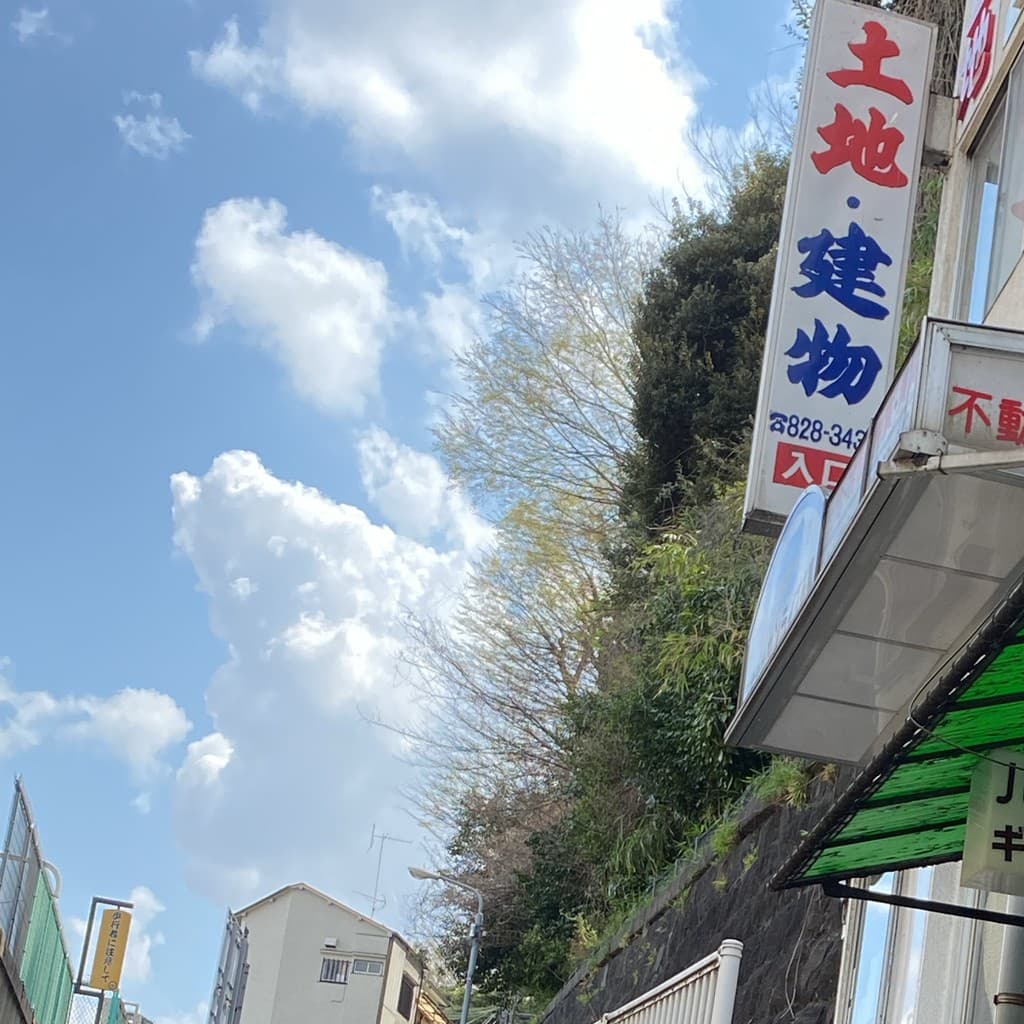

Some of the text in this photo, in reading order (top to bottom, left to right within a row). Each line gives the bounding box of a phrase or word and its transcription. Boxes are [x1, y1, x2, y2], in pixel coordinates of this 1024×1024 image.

[785, 20, 913, 405] 土地・建物
